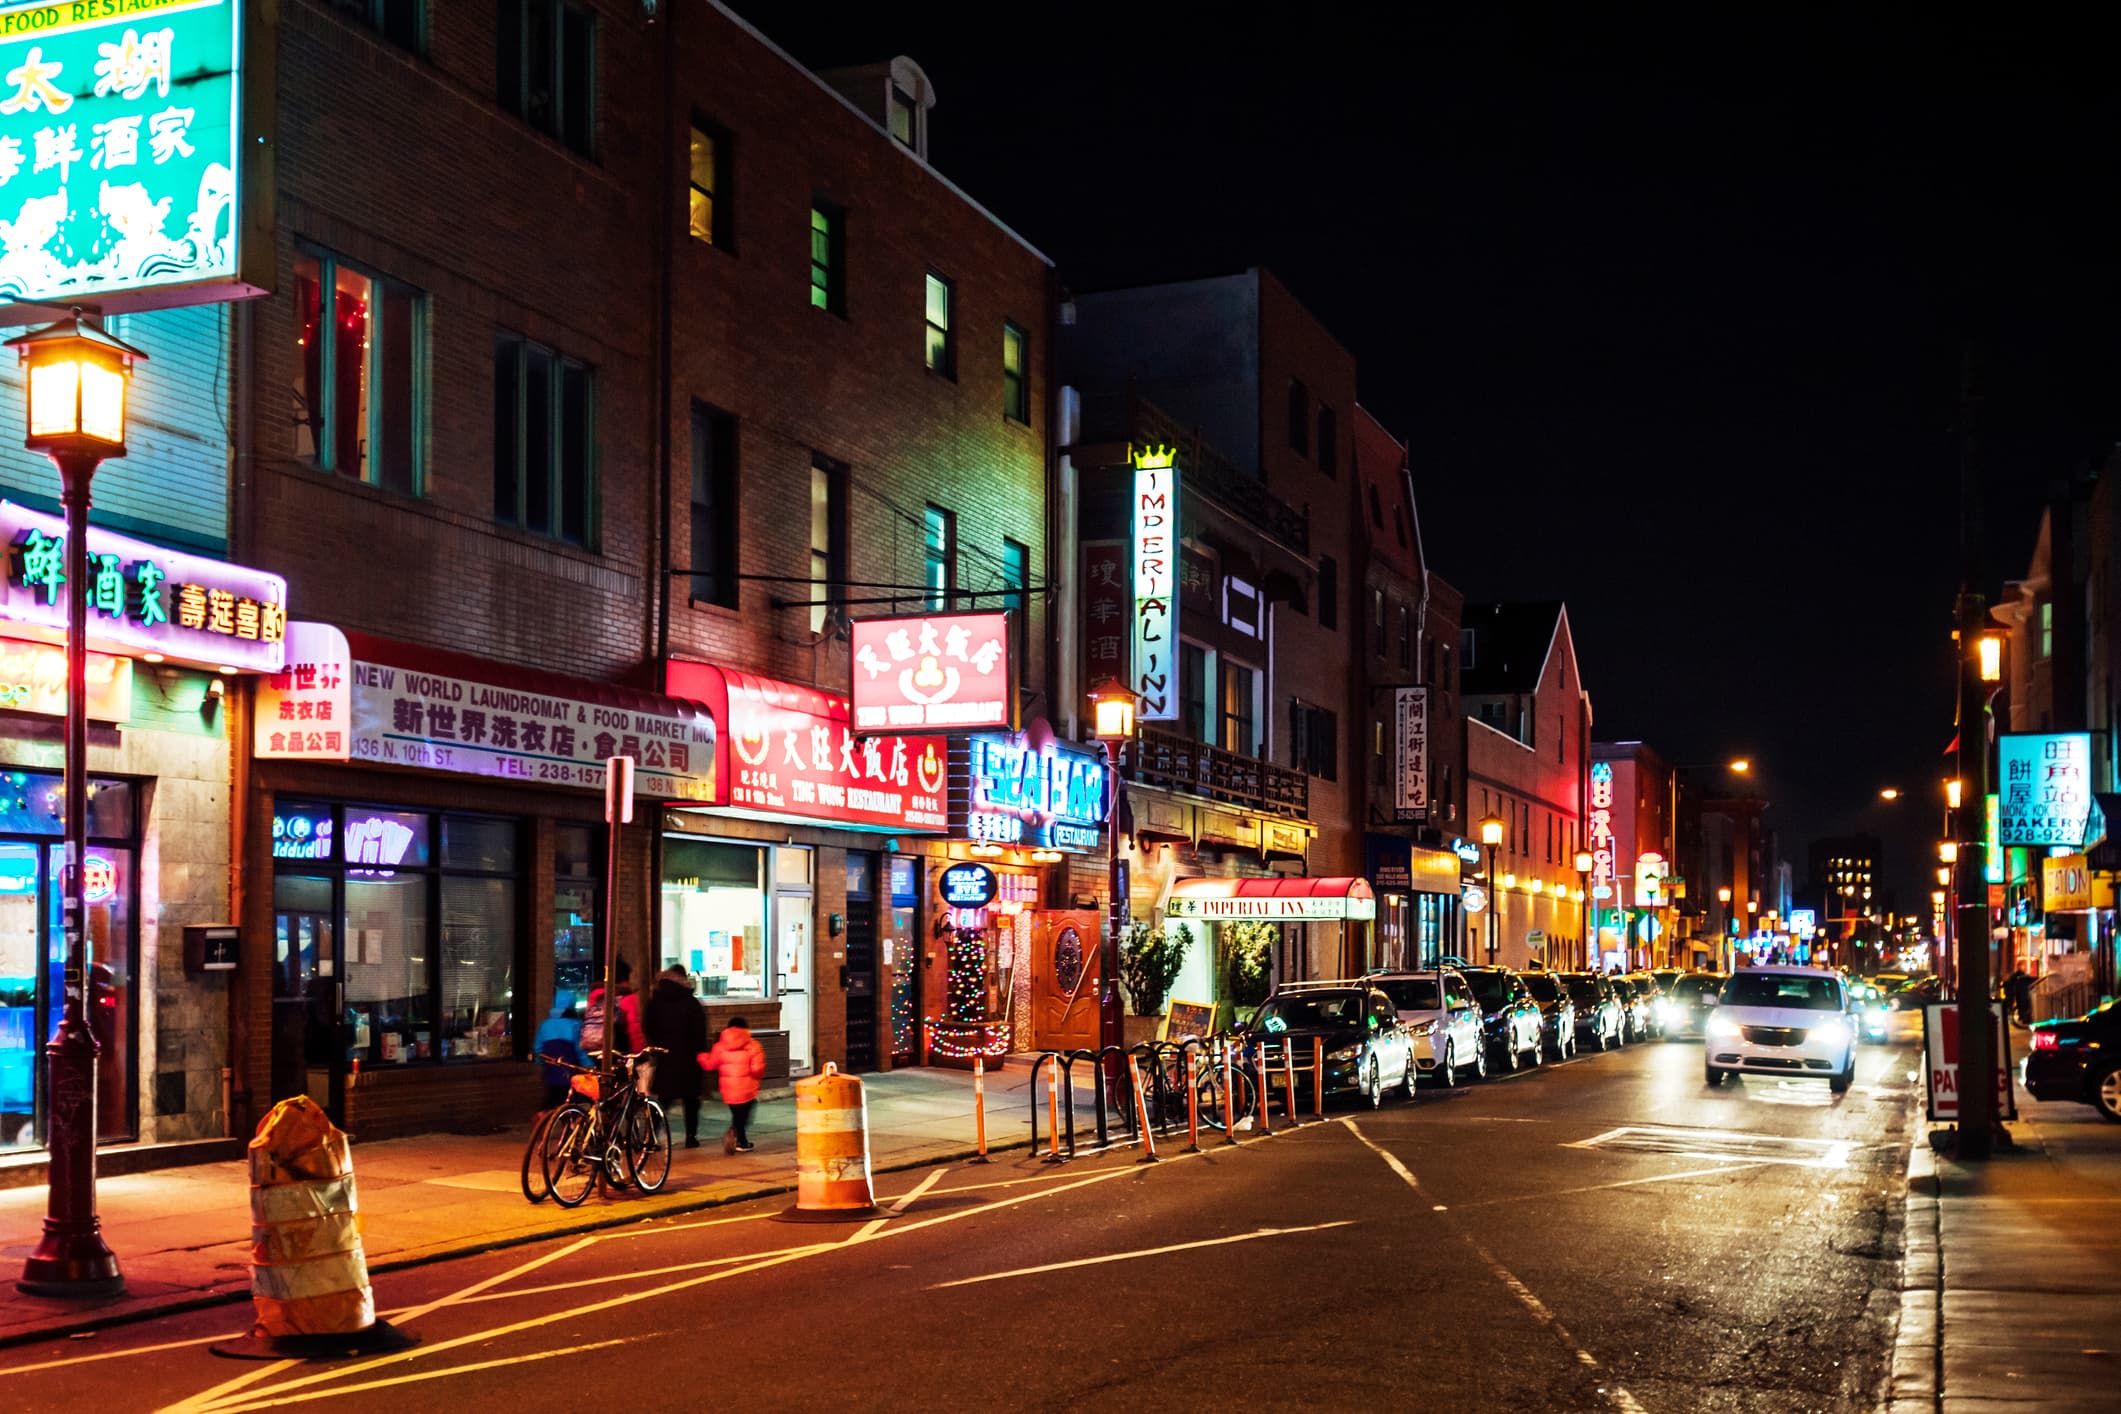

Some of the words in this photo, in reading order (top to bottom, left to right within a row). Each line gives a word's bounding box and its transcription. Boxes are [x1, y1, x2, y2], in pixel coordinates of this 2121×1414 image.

[0, 8, 59, 34] FOOD
[1140, 473, 1166, 642] IMPERIAL
[1141, 654, 1166, 715] INN
[279, 701, 333, 721] 洗衣店
[355, 665, 395, 690] NEW
[405, 673, 463, 702] WORLD
[470, 686, 570, 721] LAUNDROMAT
[577, 705, 587, 722] &
[593, 708, 629, 731] FOOD
[635, 717, 687, 741] MARKET
[270, 732, 342, 752] 食品公司
[355, 738, 378, 756] 136
[383, 741, 397, 759] N.
[402, 744, 430, 763] 10th
[496, 757, 535, 777] TEL:
[539, 762, 607, 785] 238-157
[817, 783, 845, 807] WONG
[847, 787, 902, 814] RESTAURANT
[1051, 757, 1102, 821] BAR
[2002, 818, 2086, 828] BAKERY
[1203, 901, 1268, 915] IMPERIAL
[1281, 901, 1304, 915] INN
